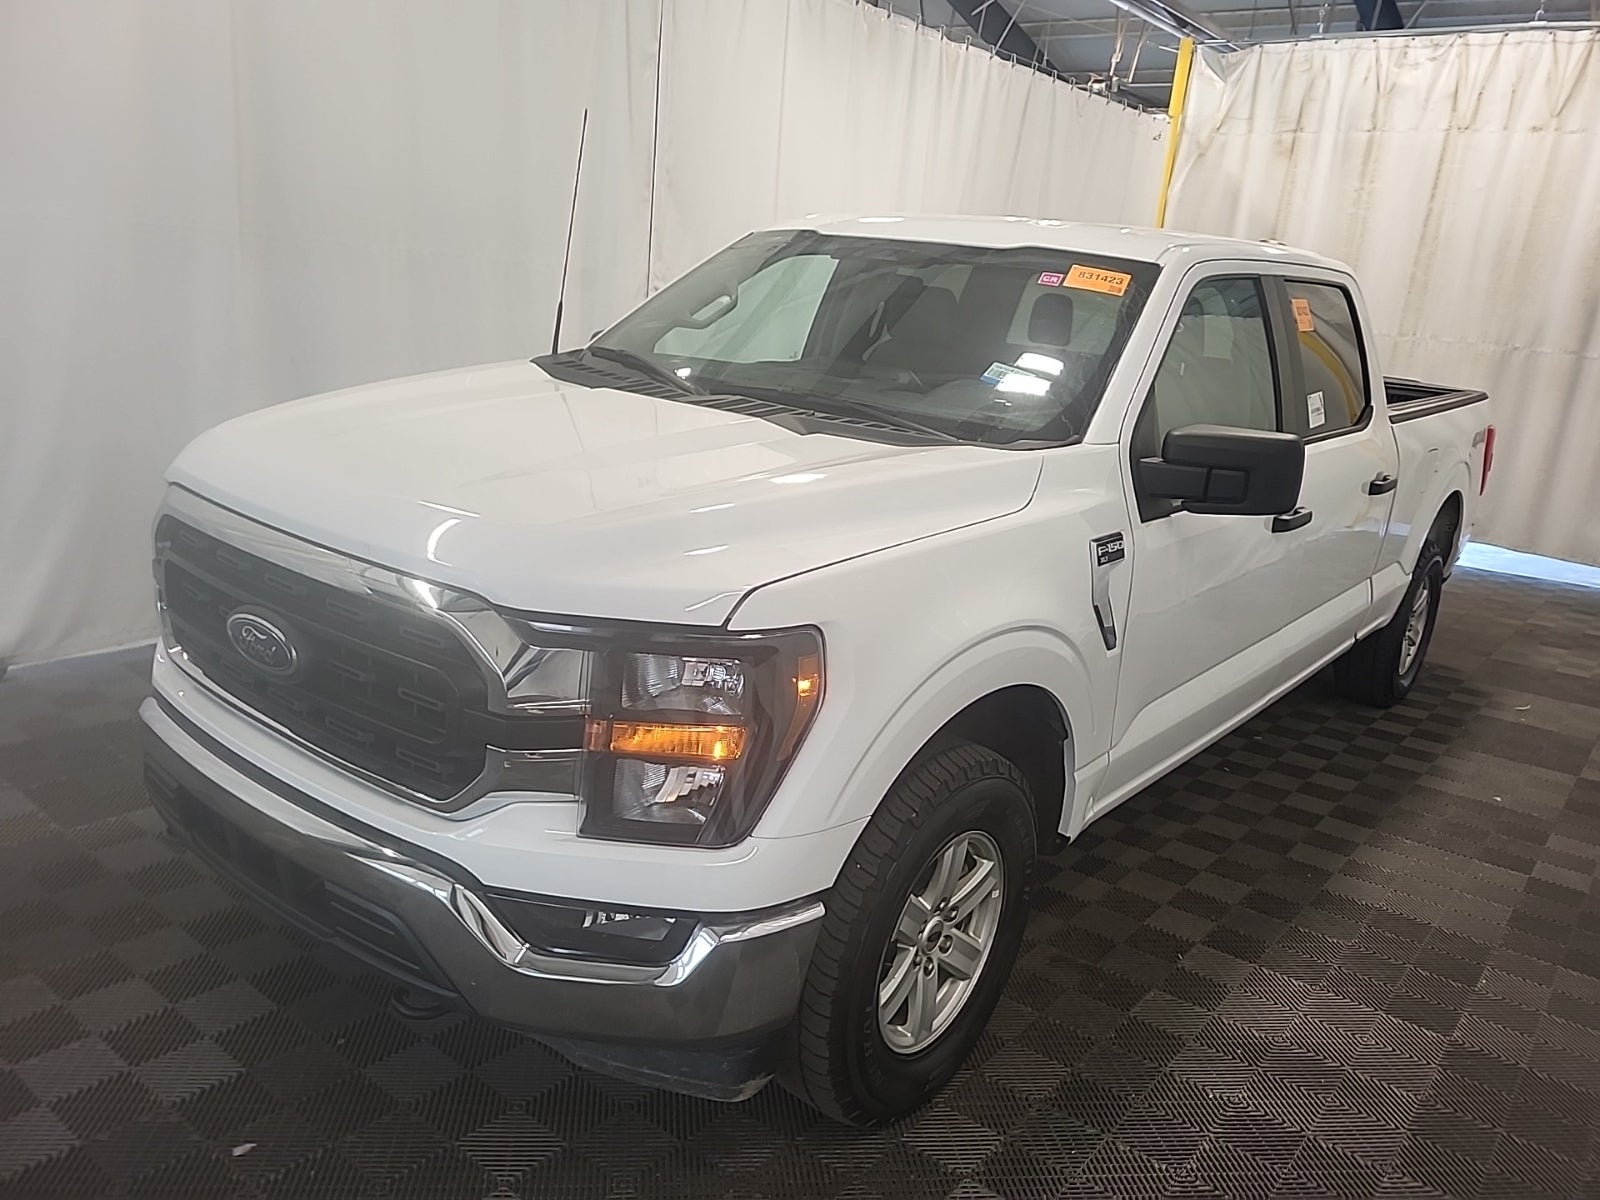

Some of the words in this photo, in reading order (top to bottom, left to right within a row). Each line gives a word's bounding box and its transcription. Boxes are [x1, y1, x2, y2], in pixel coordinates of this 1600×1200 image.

[1042, 275, 1059, 283] CR
[1078, 271, 1124, 285] 831423
[1098, 540, 1124, 556] F-150
[241, 625, 279, 665] Ford
